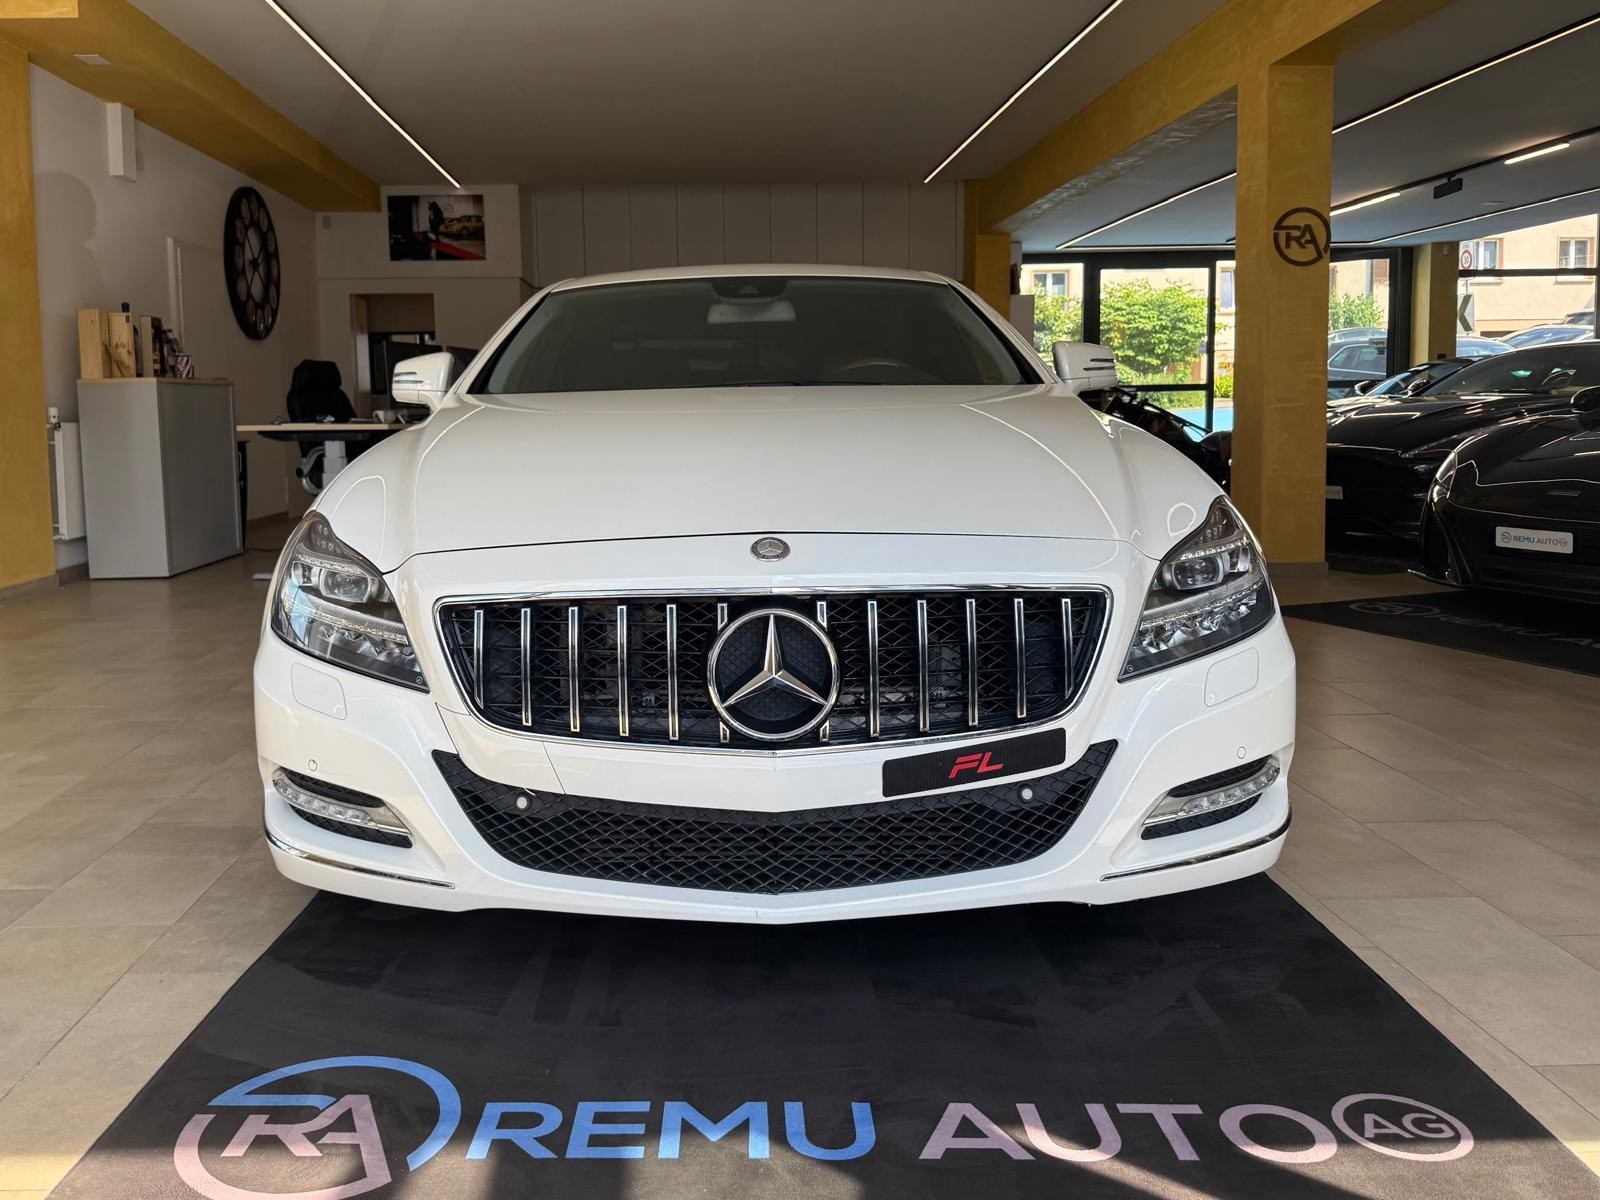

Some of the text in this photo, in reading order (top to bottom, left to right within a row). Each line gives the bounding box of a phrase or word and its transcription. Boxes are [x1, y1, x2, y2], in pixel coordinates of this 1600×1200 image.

[1274, 222, 1324, 261] RA
[1513, 535, 1535, 544] REMU
[1536, 537, 1559, 546] AUTO
[949, 752, 1004, 779] FL
[466, 1101, 876, 1160] REMU
[919, 1102, 1337, 1163] AUTO
[1363, 1112, 1454, 1139] AG
